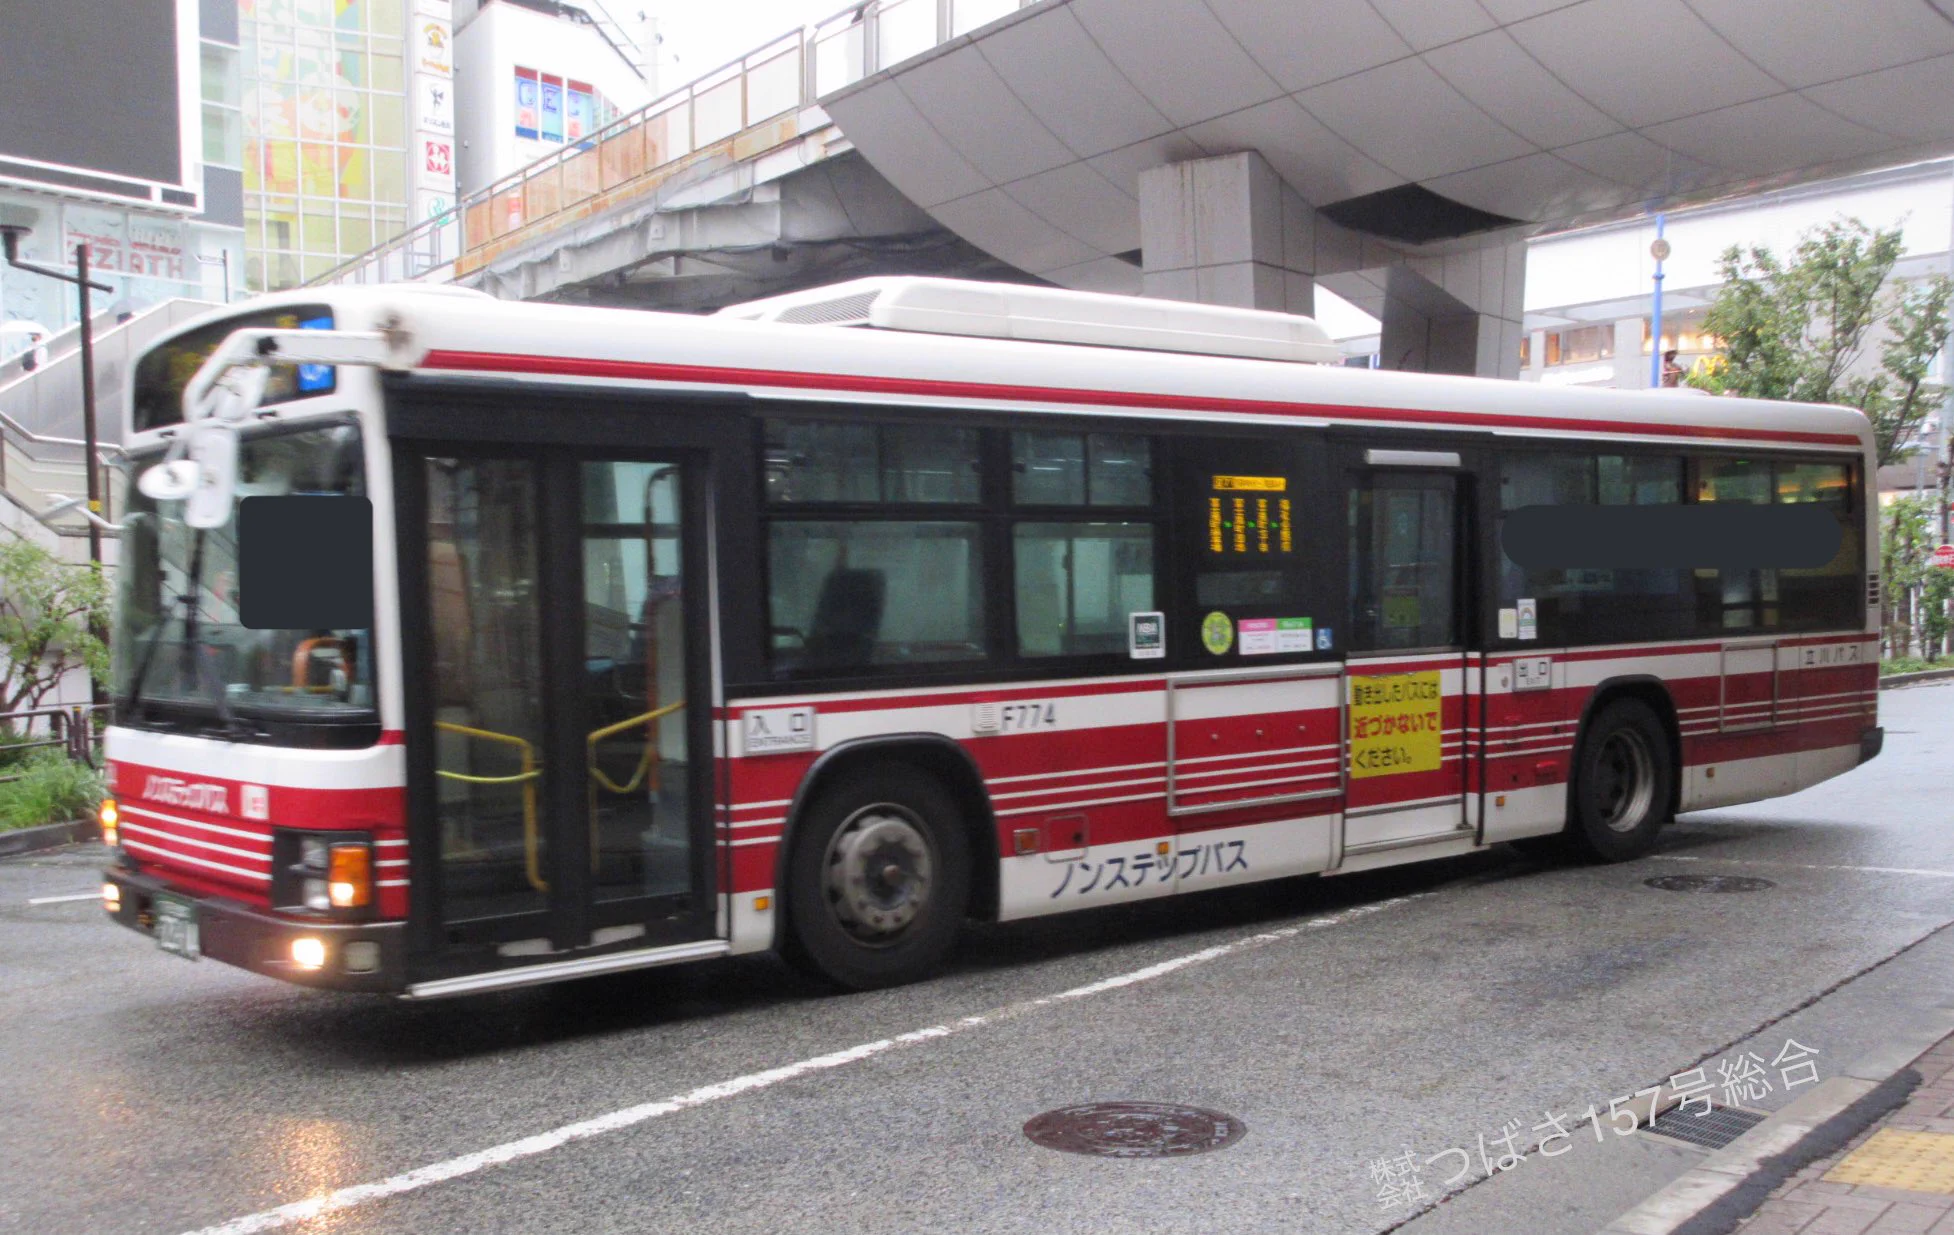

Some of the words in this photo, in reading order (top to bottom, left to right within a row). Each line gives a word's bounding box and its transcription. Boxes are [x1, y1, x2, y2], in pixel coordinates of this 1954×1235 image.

[1805, 645, 1858, 664] 立川バス
[1519, 661, 1547, 677] 出口
[748, 712, 808, 735] 入口
[1001, 703, 1055, 731] F774
[1354, 711, 1437, 739] 近づかないで
[1051, 840, 1248, 898] ノンステップバス
